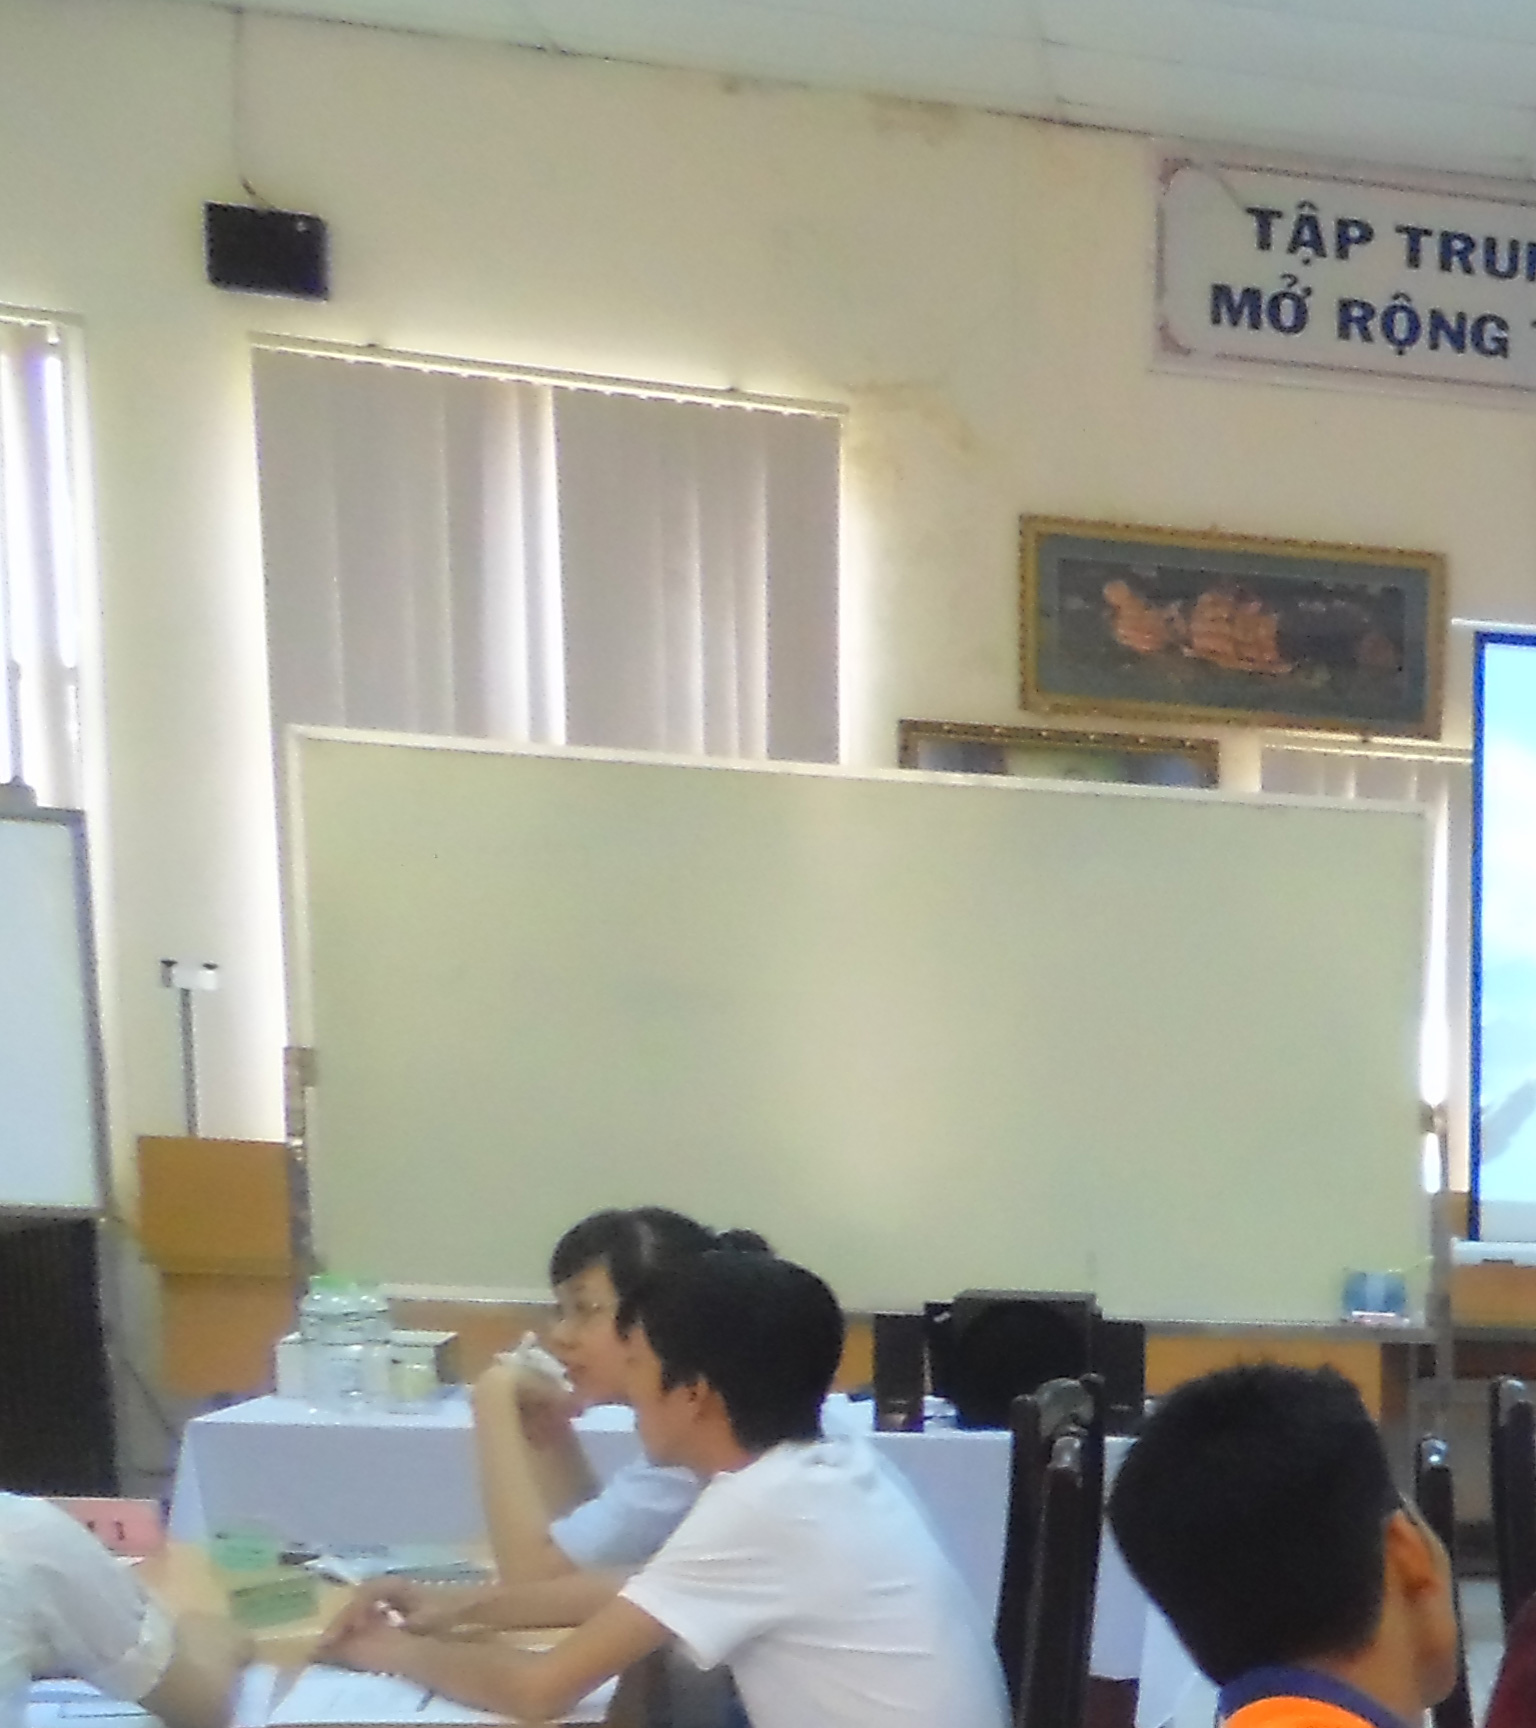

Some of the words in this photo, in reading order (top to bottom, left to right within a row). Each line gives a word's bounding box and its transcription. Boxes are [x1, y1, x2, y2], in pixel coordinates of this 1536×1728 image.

[1245, 201, 1374, 267] TẬP
[1209, 274, 1313, 336] MỞ
[1336, 290, 1512, 360] RỘNG
